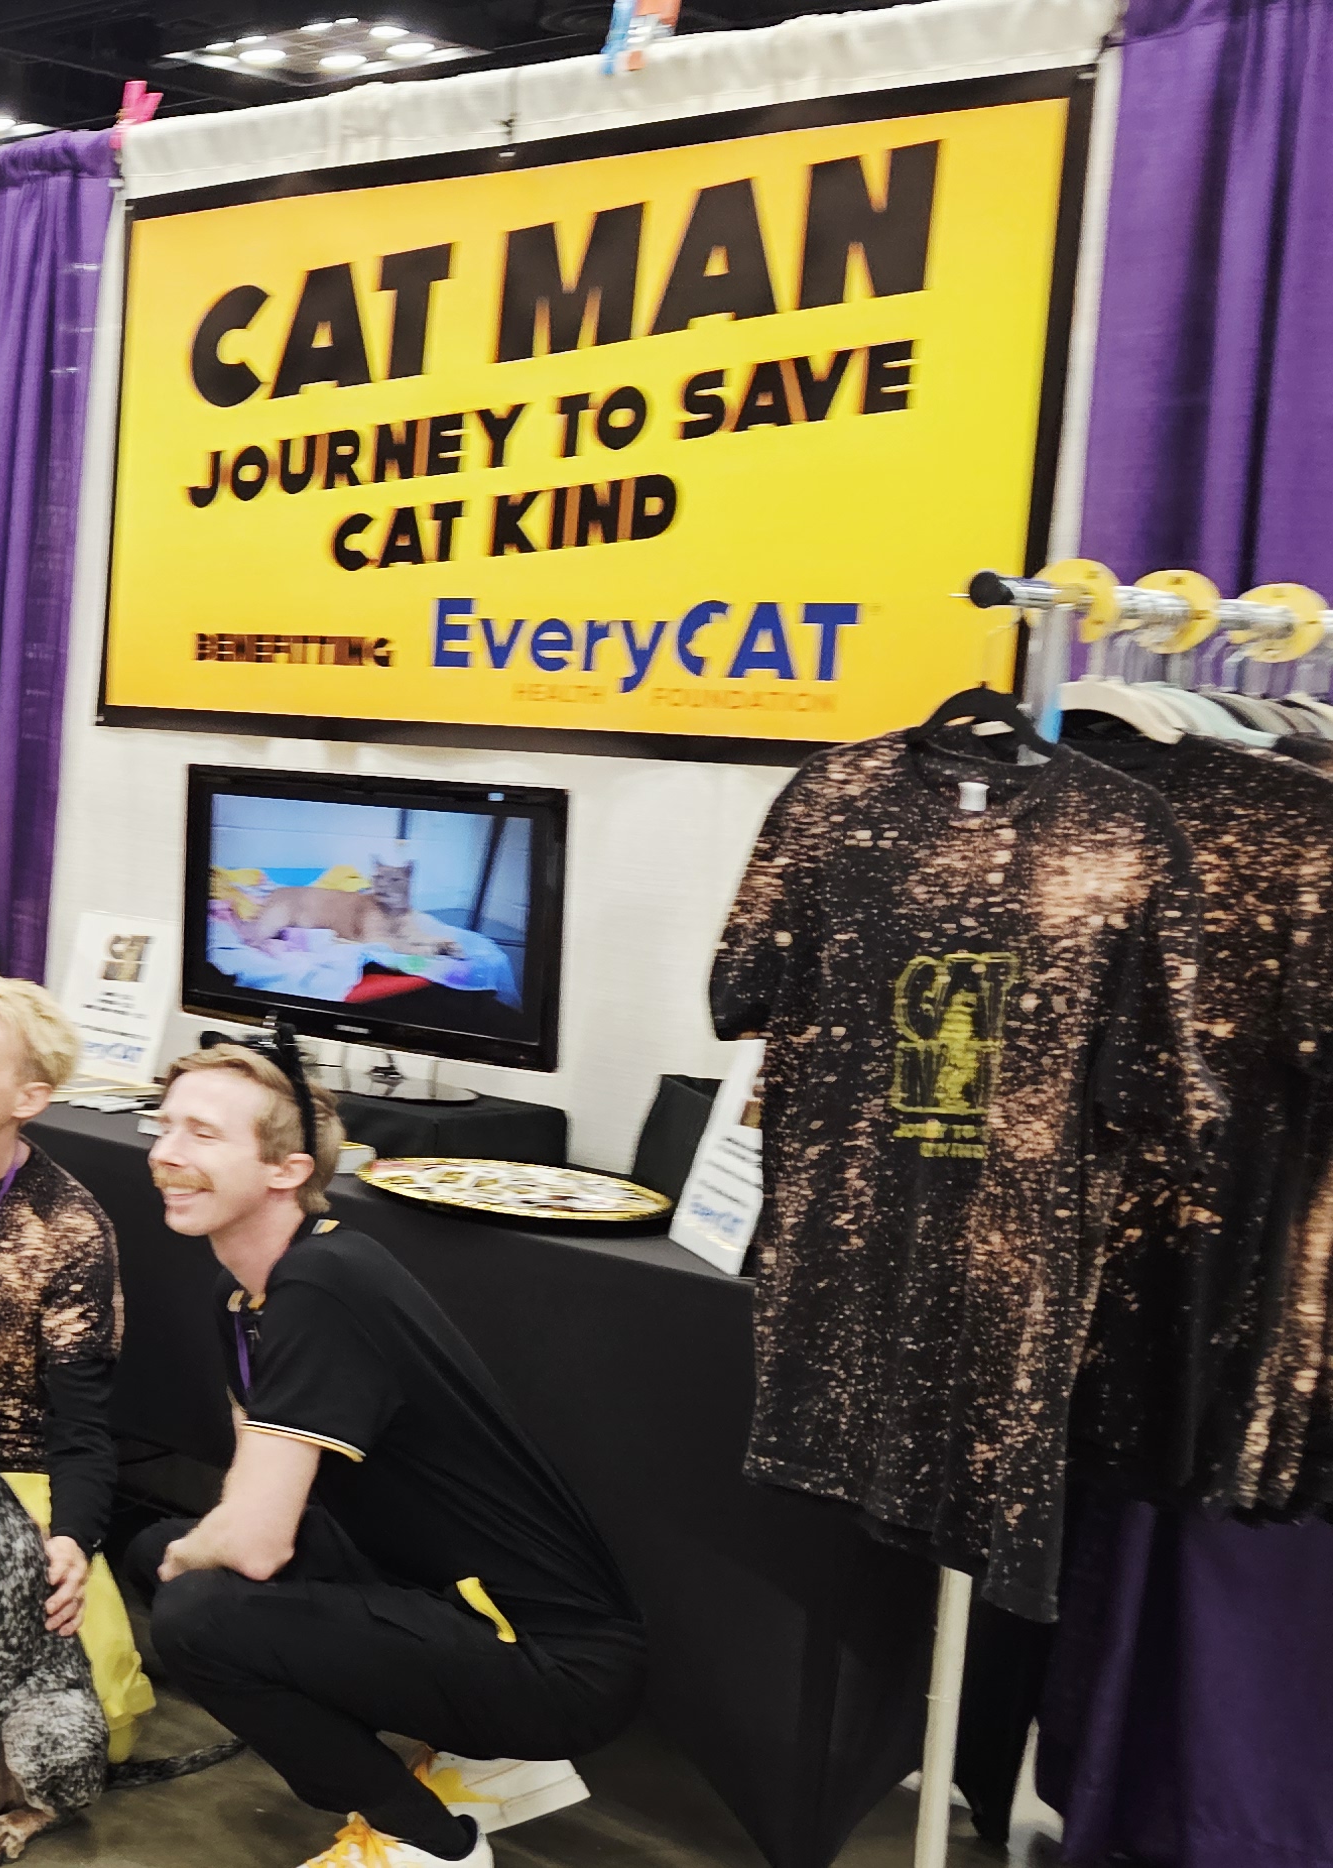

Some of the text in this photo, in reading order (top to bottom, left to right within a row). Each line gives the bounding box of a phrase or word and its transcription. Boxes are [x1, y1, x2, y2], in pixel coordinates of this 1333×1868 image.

[187, 138, 941, 408] CAT MAN
[187, 339, 920, 508] JOURNEY TO SAVE
[330, 472, 679, 572] CAT KIND
[431, 597, 863, 695] EveryCAT
[511, 683, 840, 713] HEALTH FOUNDATION
